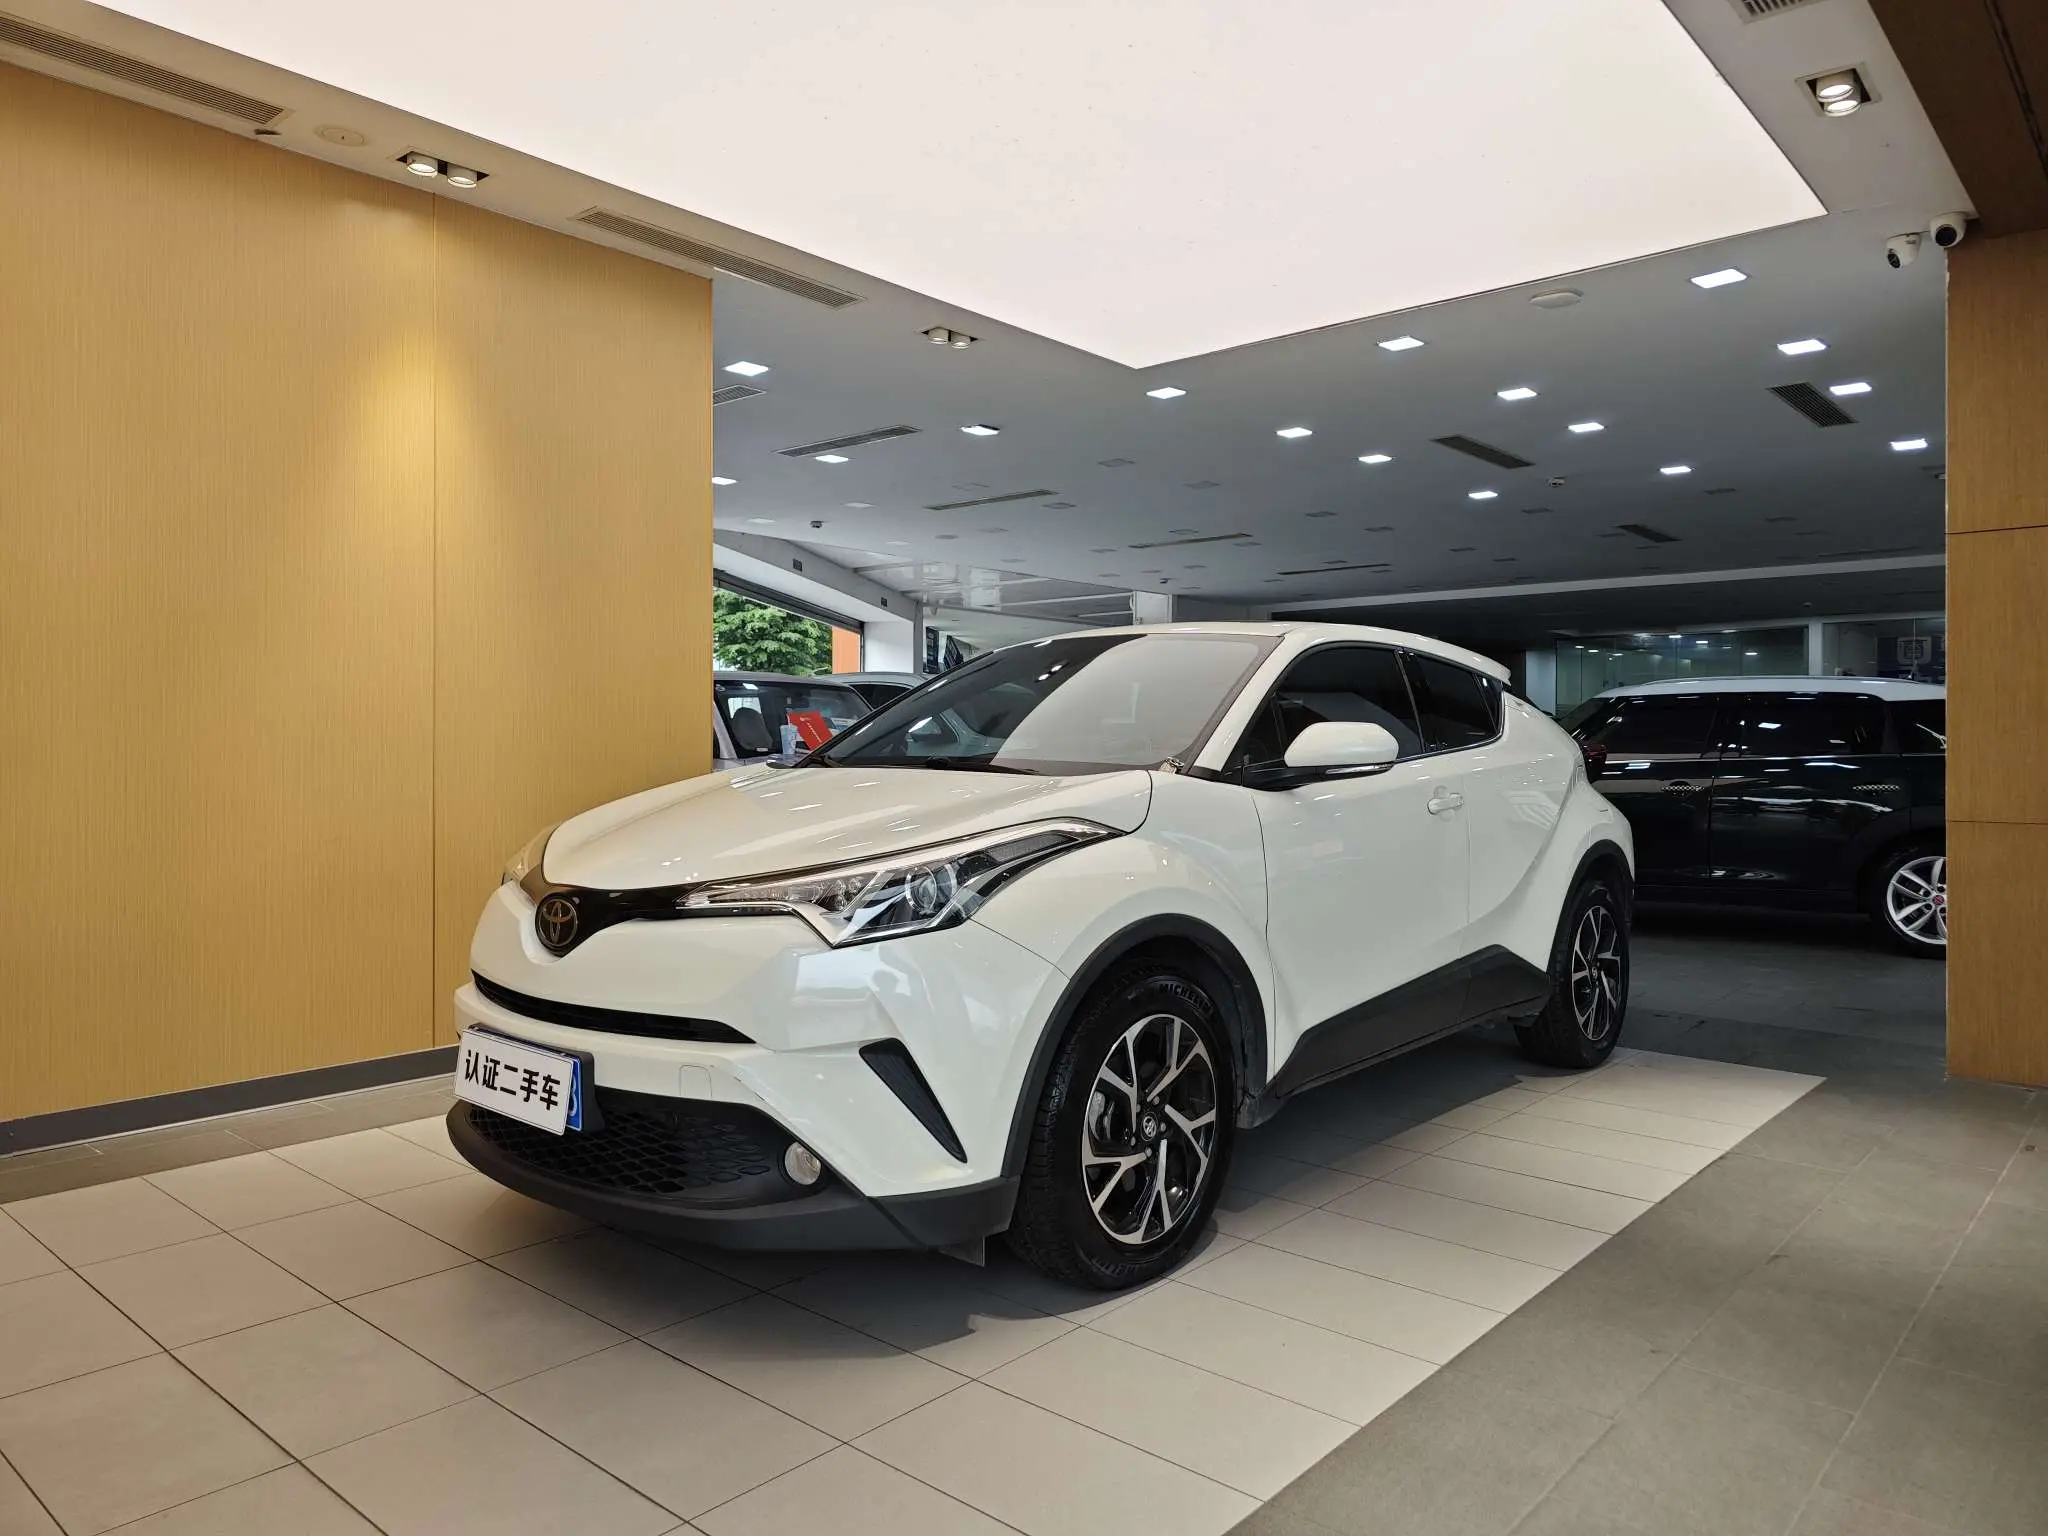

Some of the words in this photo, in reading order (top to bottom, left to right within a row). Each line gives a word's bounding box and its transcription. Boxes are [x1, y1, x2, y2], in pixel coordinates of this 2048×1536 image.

[464, 1050, 561, 1110] 认证二手车
